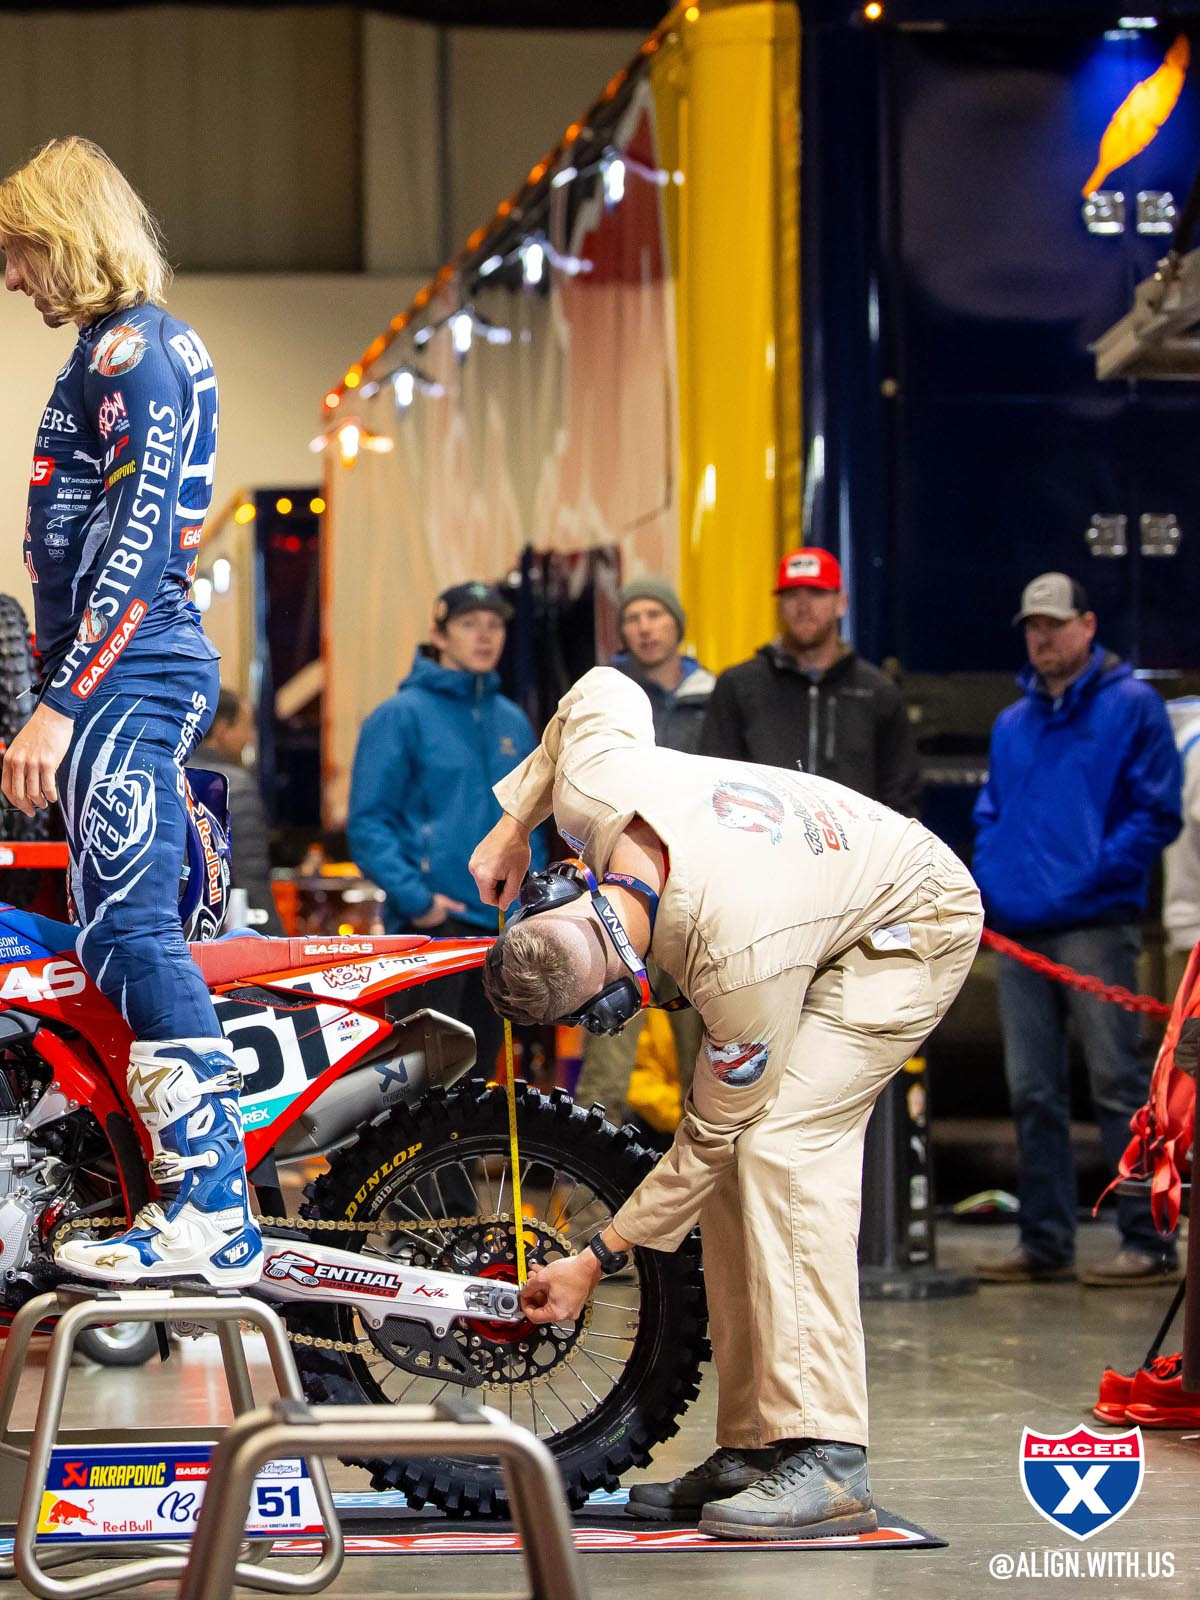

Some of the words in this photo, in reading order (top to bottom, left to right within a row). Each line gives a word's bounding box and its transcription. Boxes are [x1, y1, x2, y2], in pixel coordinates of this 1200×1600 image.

[57, 487, 93, 495] GoPro
[77, 602, 145, 697] GASGAS
[303, 943, 374, 955] GASGAS
[601, 903, 639, 959] SENA
[337, 1018, 360, 1031] AMA
[344, 1142, 423, 1222] DUNLOP
[270, 1252, 401, 1290] RENTHAL
[89, 1462, 167, 1488] AKRAPOVIČ
[103, 1521, 127, 1533] Red
[129, 1519, 153, 1532] Bull
[256, 1486, 301, 1518] 51
